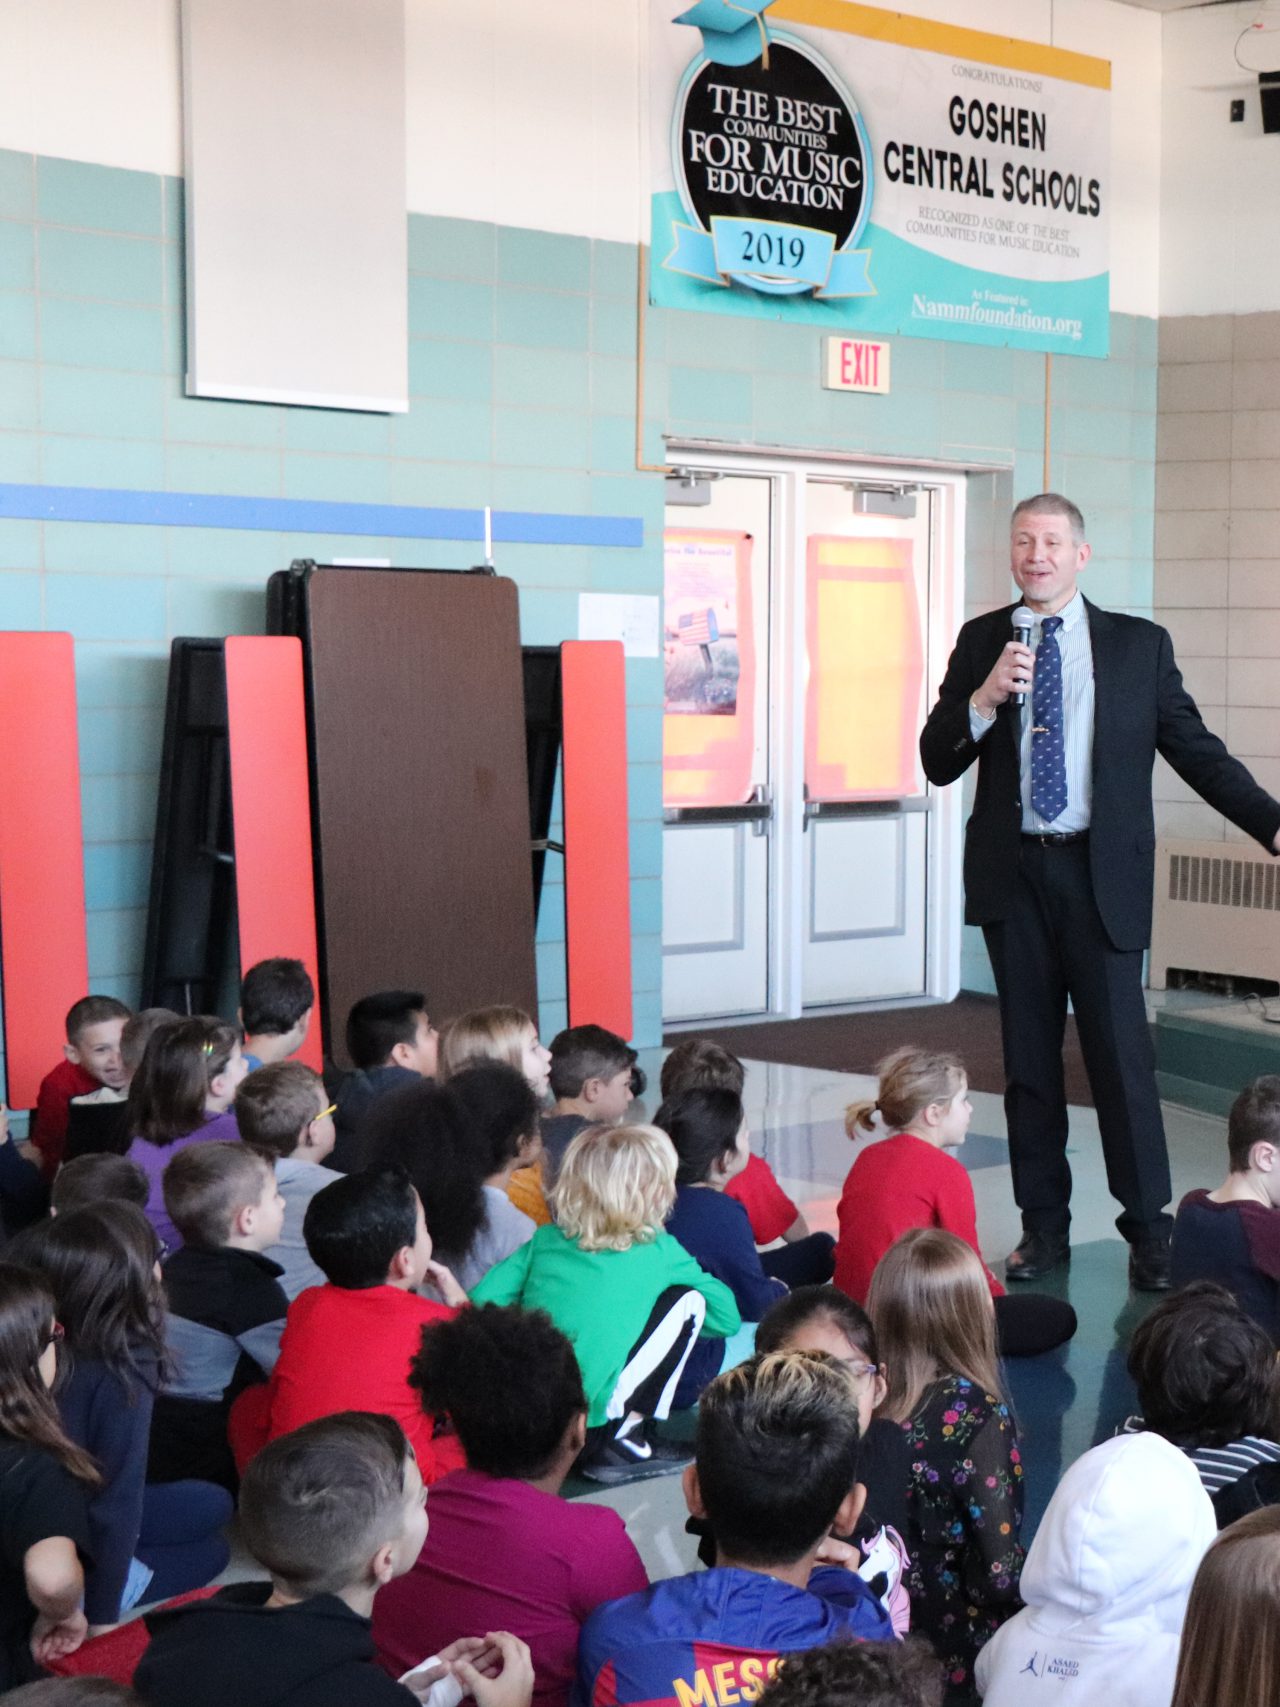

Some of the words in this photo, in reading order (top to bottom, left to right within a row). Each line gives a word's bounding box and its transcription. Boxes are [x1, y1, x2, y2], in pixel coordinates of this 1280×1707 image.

[951, 63, 1043, 94] CONGRATULATIONS!
[707, 83, 770, 123] THE
[775, 95, 842, 135] BEST
[949, 95, 1047, 152] GOSHEN
[723, 117, 828, 150] COMMUNITIES
[688, 129, 754, 172] FOR
[762, 141, 861, 189] MUSIC
[883, 140, 995, 199] CENTRAL
[1002, 161, 1101, 218] SCHOOLS
[706, 166, 844, 211] EDUCATION
[906, 219, 977, 243] COMMUNITIES
[978, 230, 997, 246] FOR
[999, 233, 1032, 251] MUSIC
[1032, 238, 1080, 259] EDUCATION
[918, 205, 980, 228] RECOGNIZED
[981, 217, 994, 230] AS
[994, 218, 1015, 233] ONE
[1017, 221, 1030, 236] OF
[1033, 223, 1048, 238] THE
[1050, 226, 1071, 242] BEST
[741, 230, 805, 269] 2019
[911, 293, 1083, 342] Nammfoundation.org
[841, 341, 881, 387] EXIT
